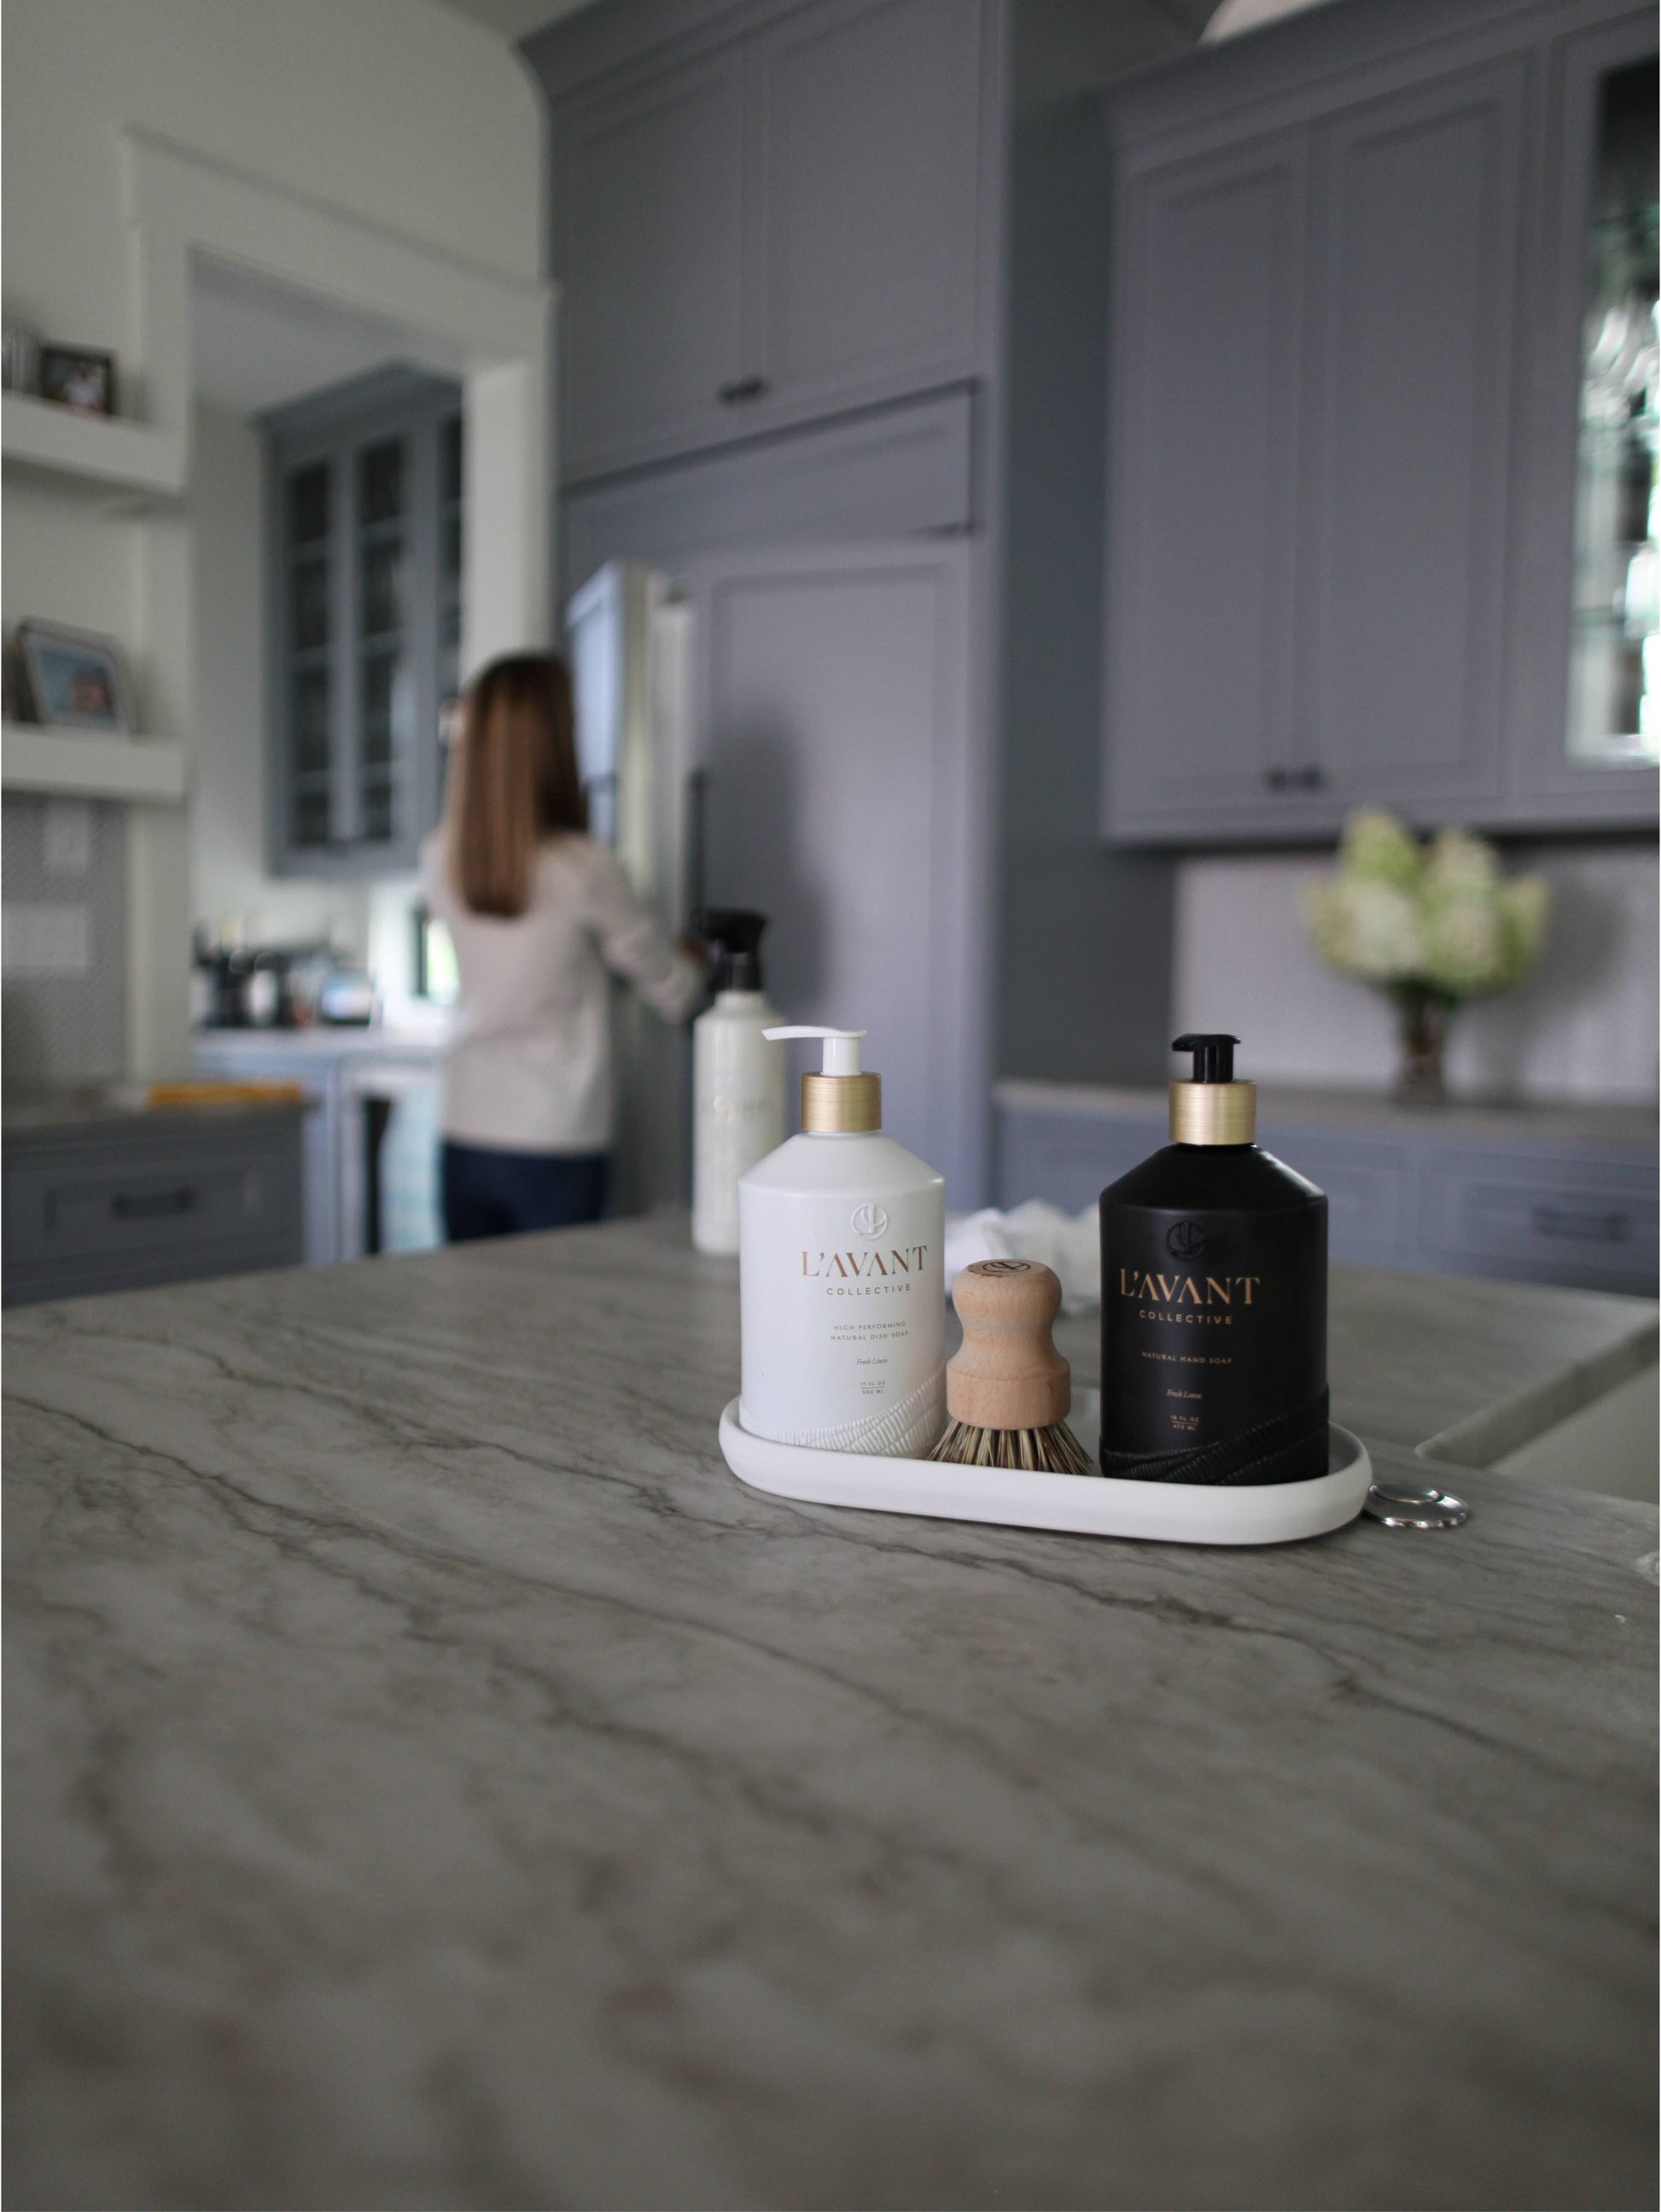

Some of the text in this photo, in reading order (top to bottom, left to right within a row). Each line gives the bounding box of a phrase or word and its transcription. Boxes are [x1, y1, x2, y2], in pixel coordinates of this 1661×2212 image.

[801, 1245, 927, 1277] L'AVANT
[826, 1283, 911, 1296] COLLECTIVE
[1120, 1268, 1261, 1304] L'AVANT
[1139, 1310, 1233, 1325] COLLECTIVE
[858, 1320, 906, 1330] PERFORMING
[1142, 1351, 1176, 1362] NATURAL
